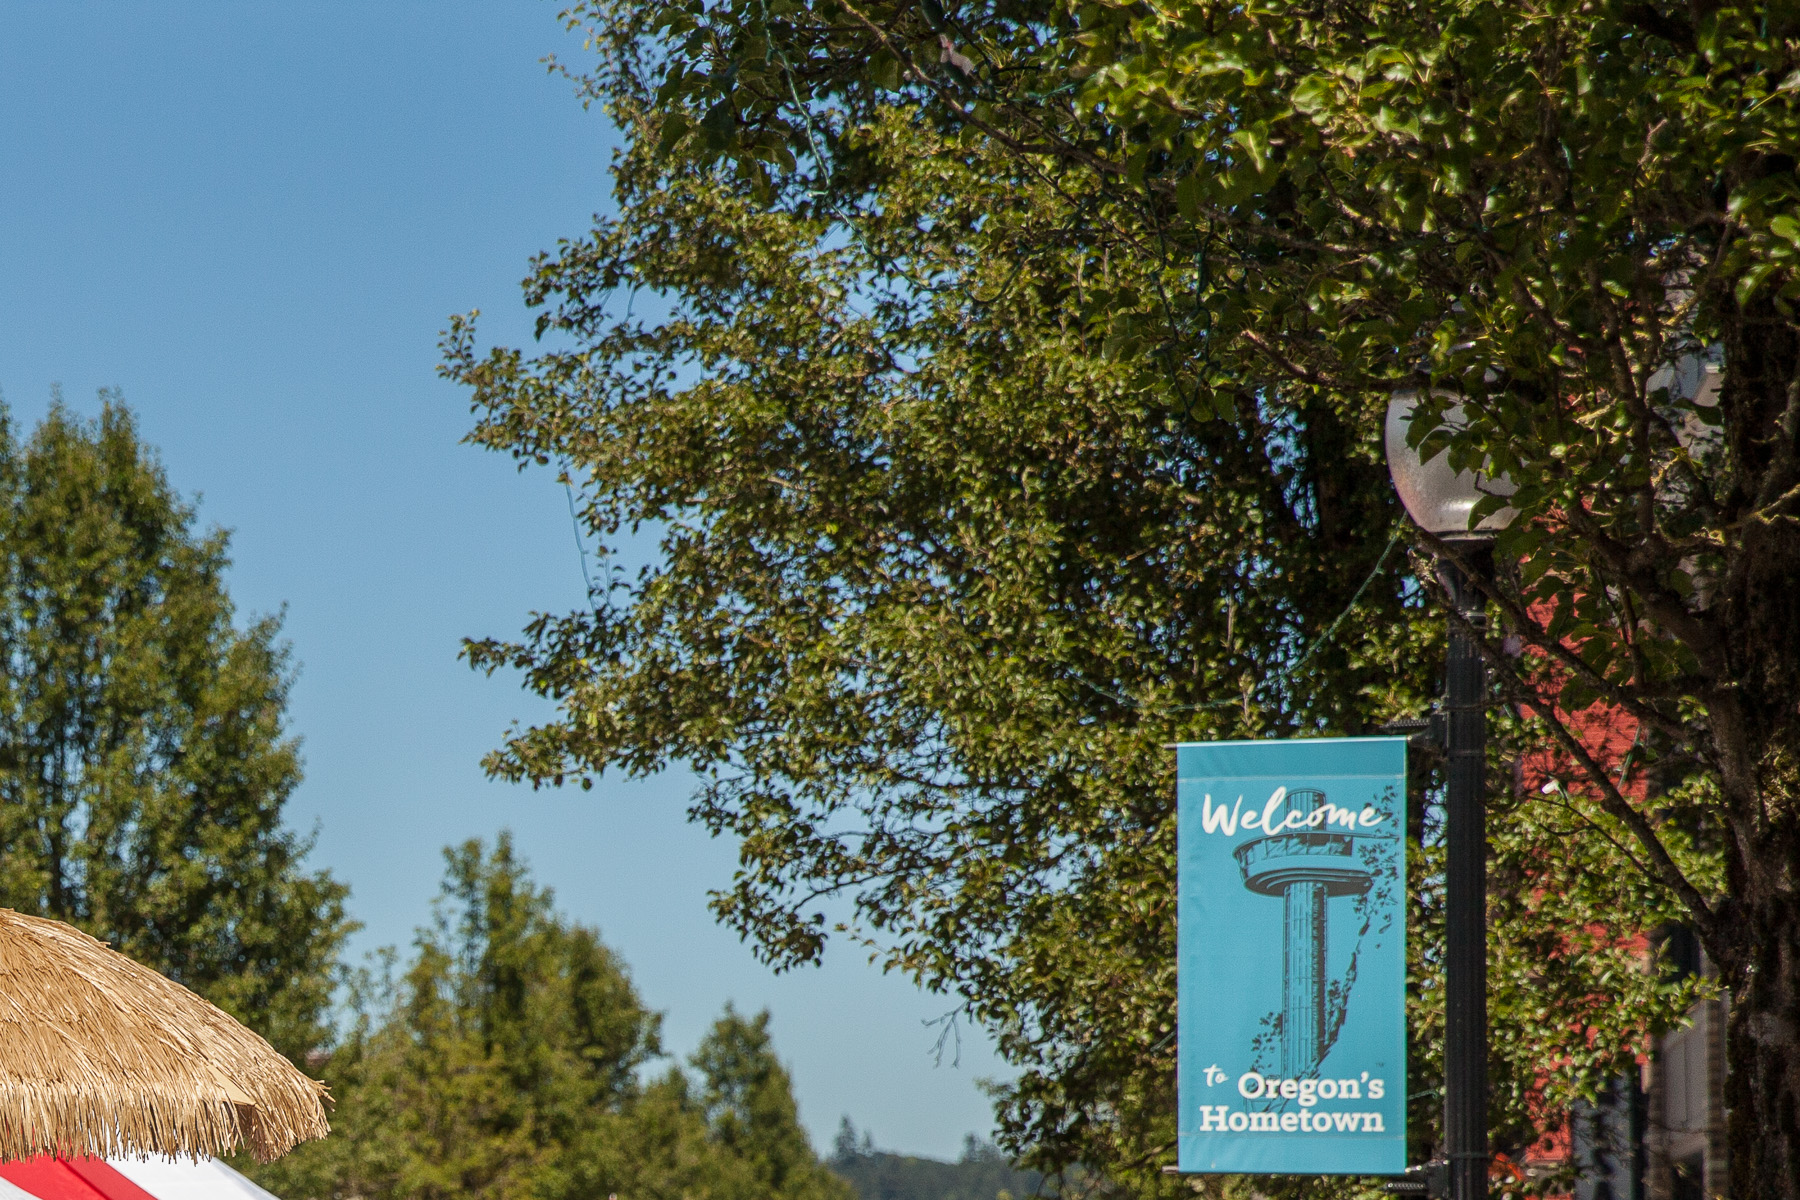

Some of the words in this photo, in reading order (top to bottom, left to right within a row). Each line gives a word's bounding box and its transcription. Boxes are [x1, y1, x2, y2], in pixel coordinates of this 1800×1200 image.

[1202, 787, 1385, 837] Welcome
[1204, 1063, 1228, 1088] to
[1238, 1070, 1384, 1106] Oregon's
[1200, 1105, 1384, 1132] Hometown
